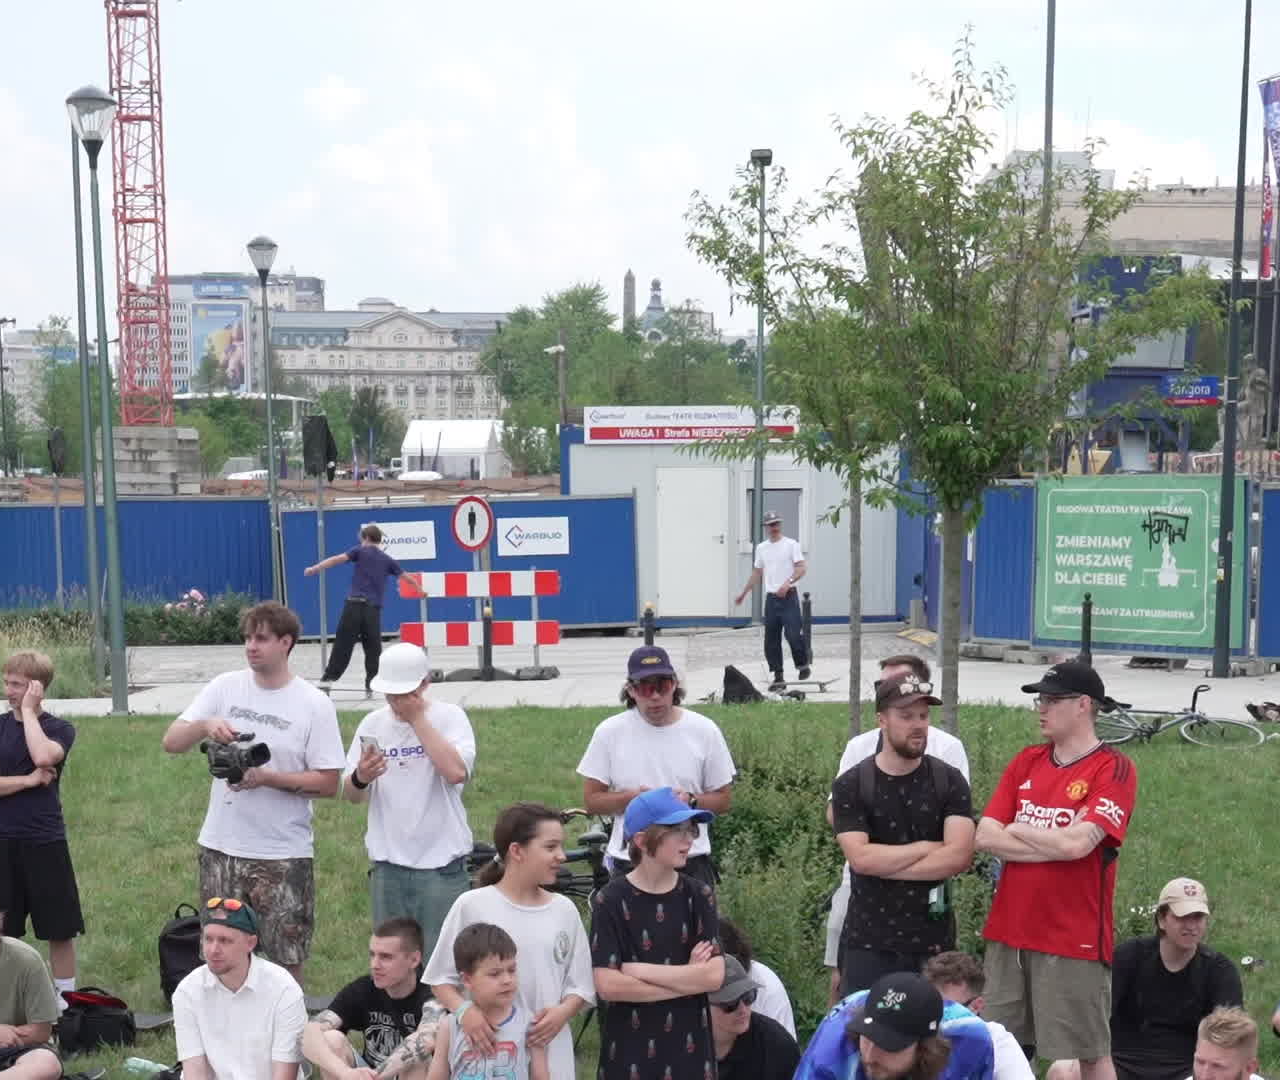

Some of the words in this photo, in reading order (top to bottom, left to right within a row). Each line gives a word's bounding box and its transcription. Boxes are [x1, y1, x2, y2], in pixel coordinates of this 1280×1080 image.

[620, 428, 654, 438] UWAGA
[514, 531, 562, 540] WARBUD
[1055, 535, 1132, 548] ZMIENIAMY
[1055, 554, 1133, 570] WARSZAWĘ
[1055, 572, 1081, 585] DLA
[1082, 573, 1127, 586] CIEBIE
[1095, 797, 1125, 825] DXC
